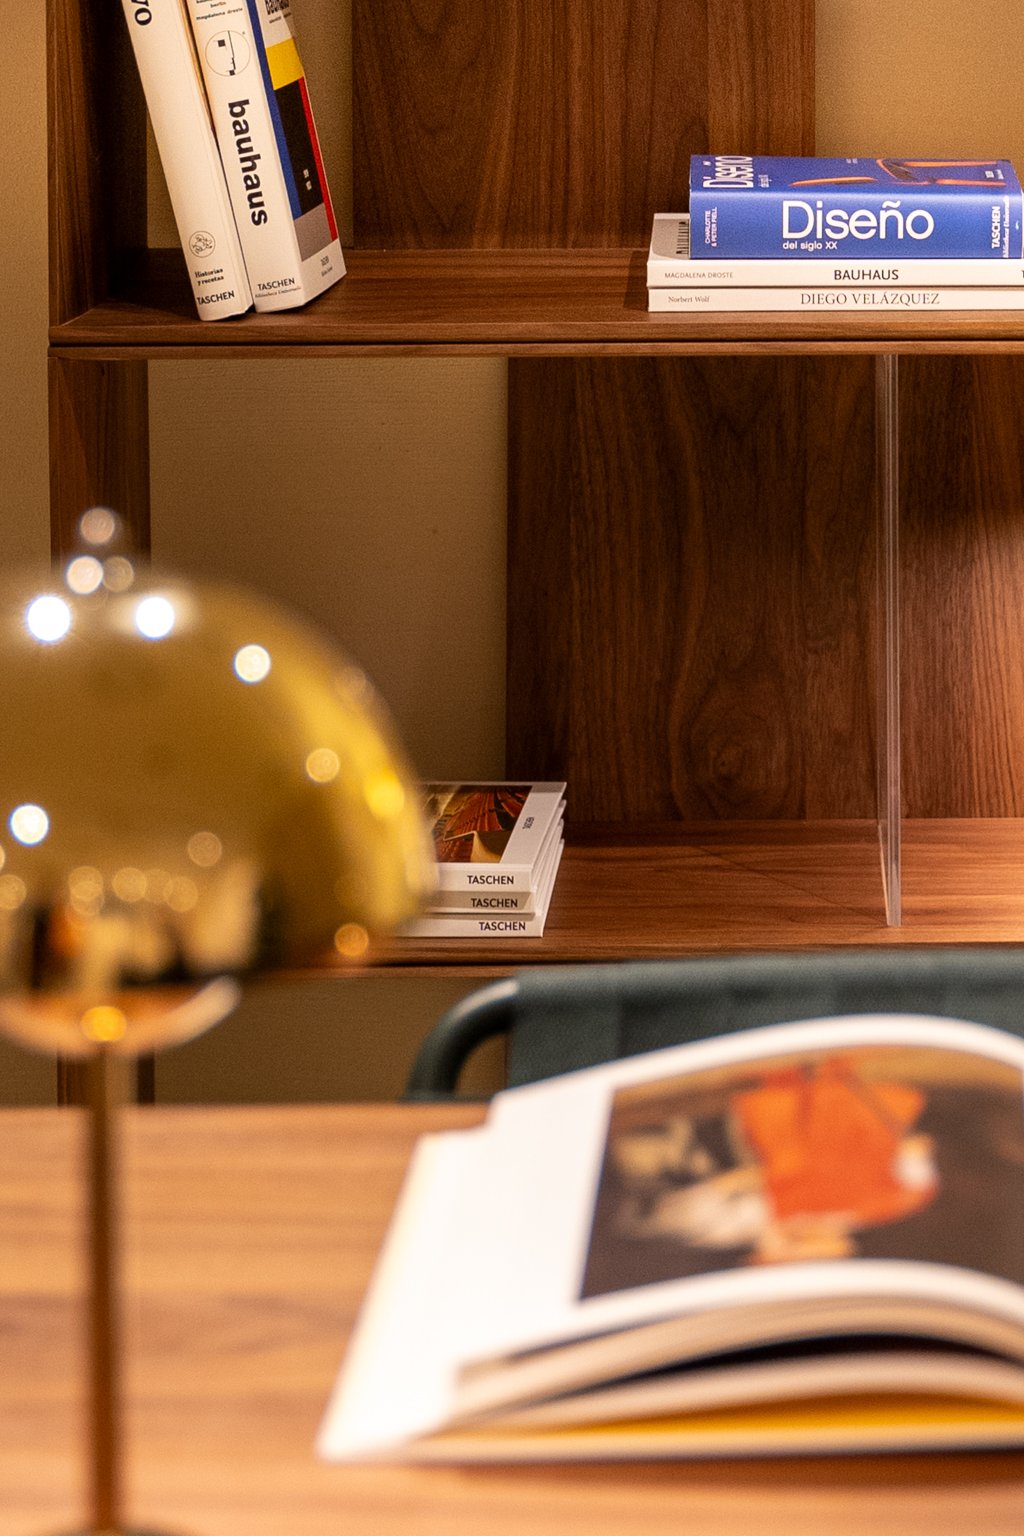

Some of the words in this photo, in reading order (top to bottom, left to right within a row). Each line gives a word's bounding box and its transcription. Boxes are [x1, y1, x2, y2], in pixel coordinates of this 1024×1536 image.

[228, 99, 268, 227] bauhaus
[703, 155, 754, 188] Diseño
[782, 200, 935, 240] Diseño
[991, 206, 1001, 249] TASCHEN
[782, 241, 797, 250] del
[800, 241, 822, 252] siglo
[825, 241, 838, 250] XX
[194, 268, 223, 278] Historias
[202, 275, 224, 284] recetas
[834, 269, 899, 281] BAUHAUS
[257, 277, 295, 291] TASCHEN
[197, 290, 235, 305] TASCHEN
[801, 293, 847, 305] DIEGO
[852, 291, 940, 306] VELÁZQUEZ
[467, 875, 514, 885] TASCHEN
[471, 898, 518, 908] TASCHEN
[479, 921, 526, 931] TASCHEN
